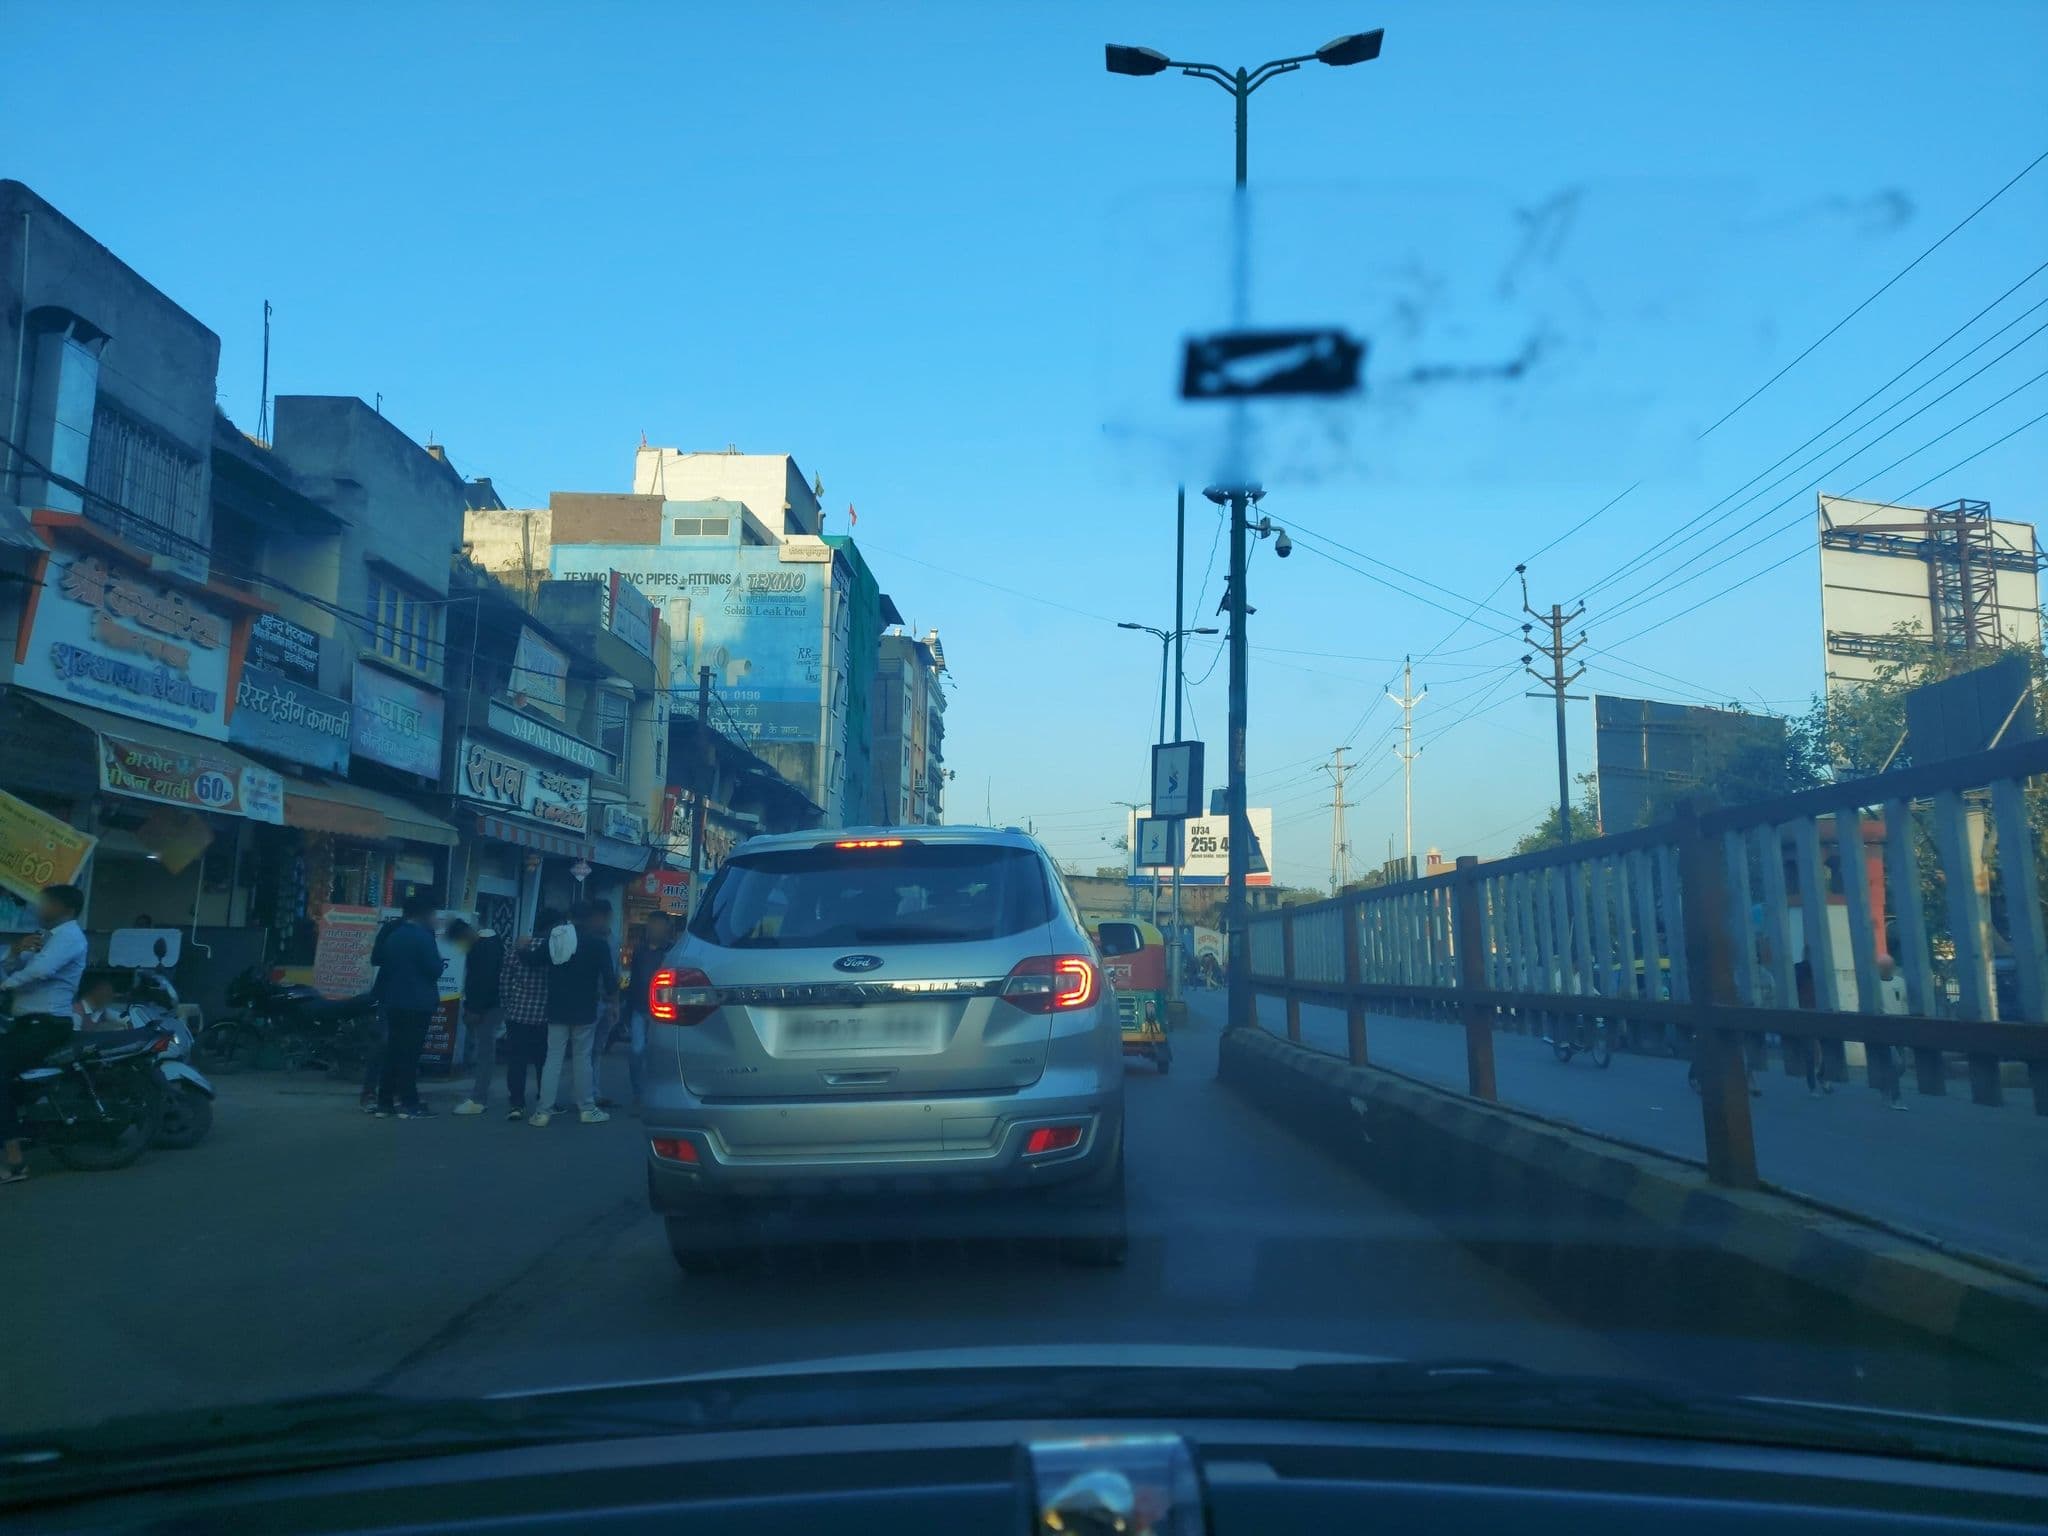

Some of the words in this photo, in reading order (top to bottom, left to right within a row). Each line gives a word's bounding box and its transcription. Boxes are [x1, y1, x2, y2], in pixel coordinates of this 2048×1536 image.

[646, 573, 678, 585] PIPES
[688, 573, 732, 585] FITTINGS
[746, 572, 806, 593] TEXMO
[755, 606, 781, 616] Leak
[784, 606, 807, 617] Proof
[511, 715, 552, 750] SAPNA
[553, 734, 597, 768] SWEETS
[468, 744, 531, 806] सपना
[200, 774, 224, 802] 60
[1191, 826, 1210, 835] 0734
[1191, 837, 1217, 852] 255
[21, 853, 54, 884] 60
[843, 956, 872, 968] Ford
